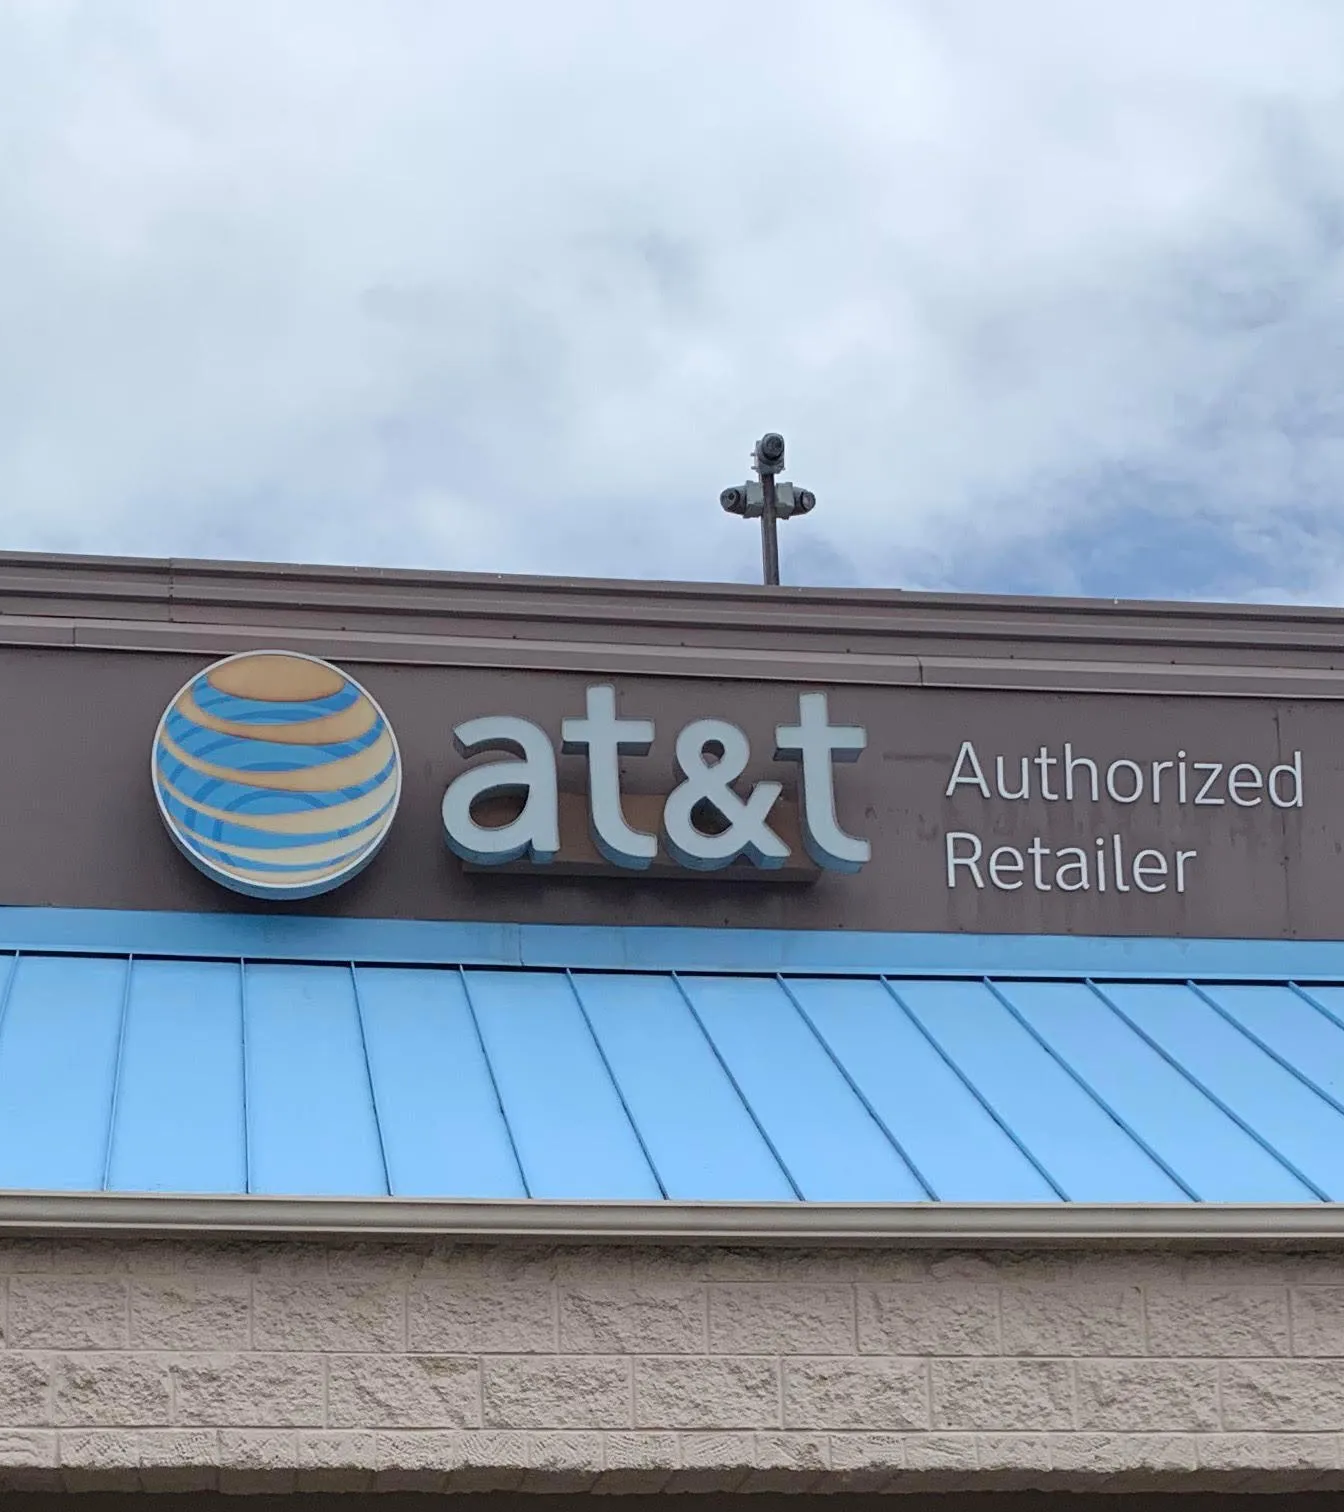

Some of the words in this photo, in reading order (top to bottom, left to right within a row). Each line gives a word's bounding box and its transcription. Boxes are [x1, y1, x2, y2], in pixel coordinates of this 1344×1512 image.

[441, 683, 872, 872] at&t
[945, 741, 1304, 808] Authorized
[945, 831, 1197, 893] Retailer
